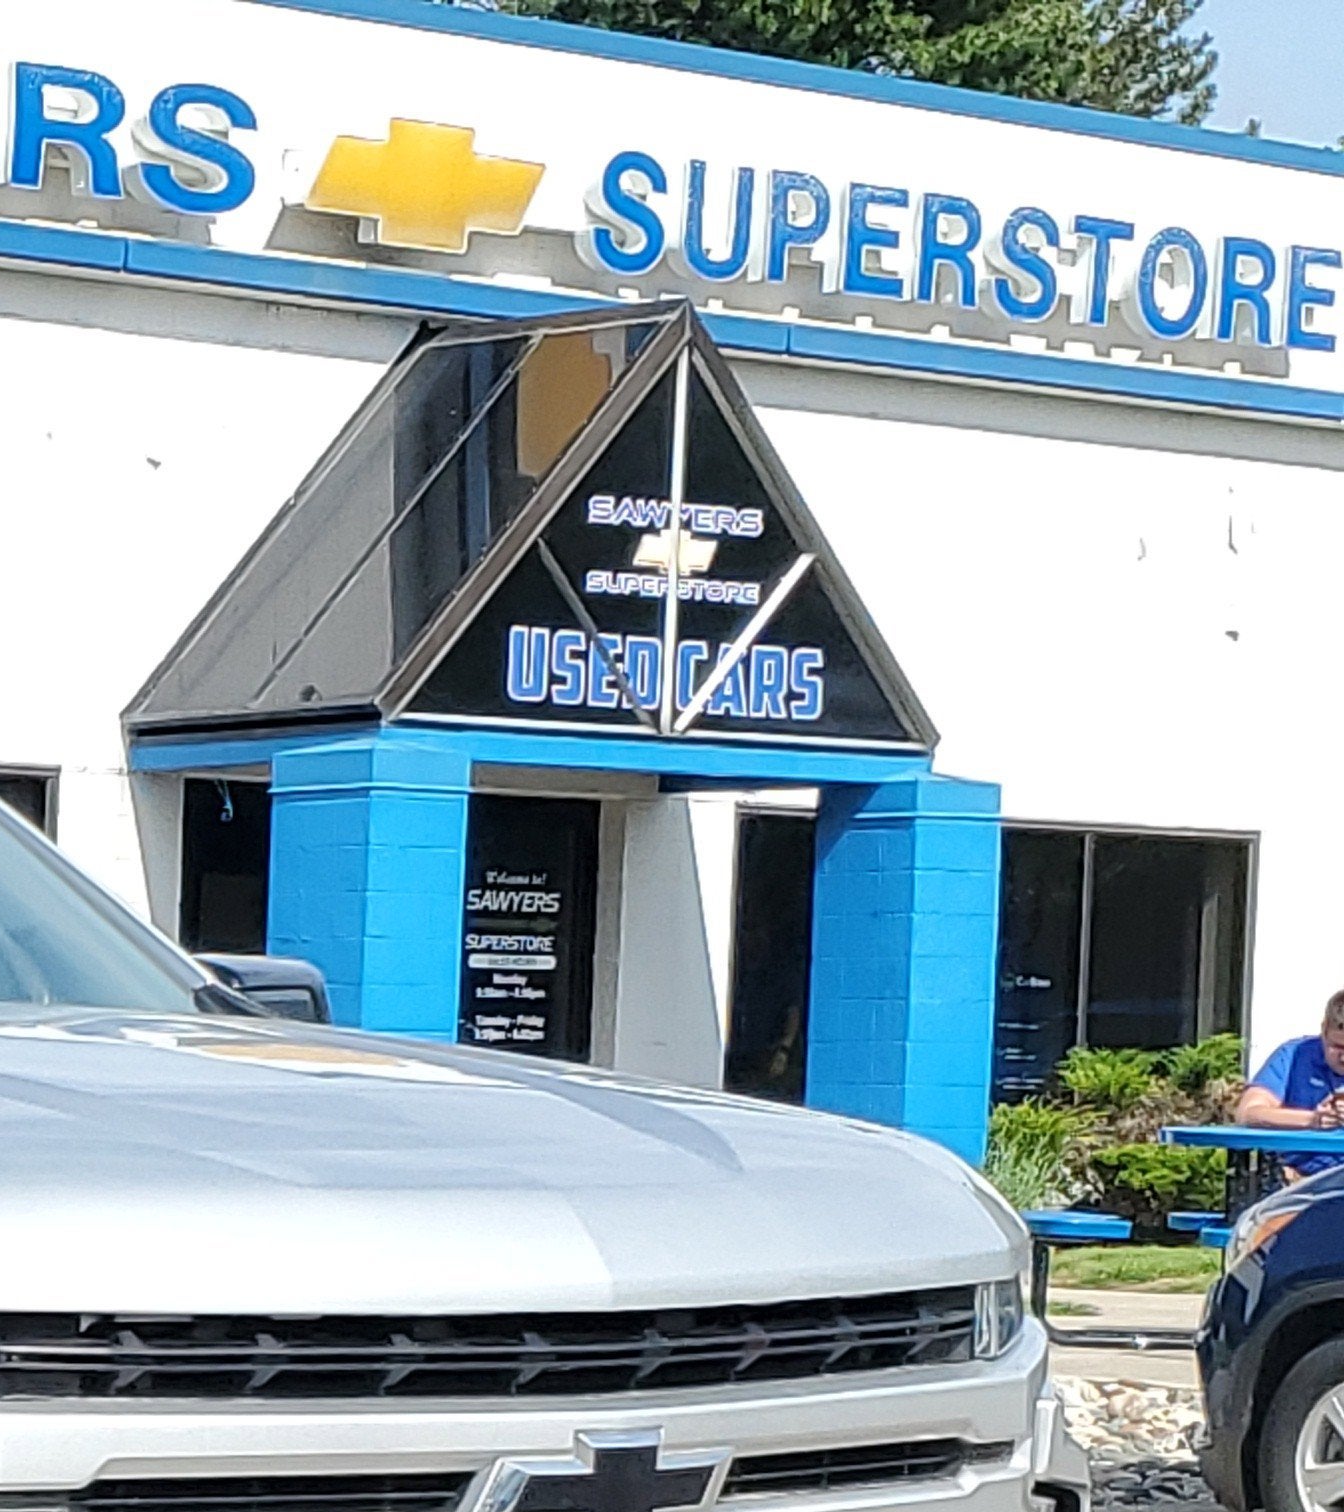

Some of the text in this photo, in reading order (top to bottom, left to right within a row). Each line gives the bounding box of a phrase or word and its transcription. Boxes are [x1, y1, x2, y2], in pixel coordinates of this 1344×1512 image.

[588, 150, 1342, 351] SUPERSTORE
[506, 625, 824, 720] USED CARS
[466, 889, 561, 913] SAWYERS
[465, 933, 555, 952] SUPERSTORE
